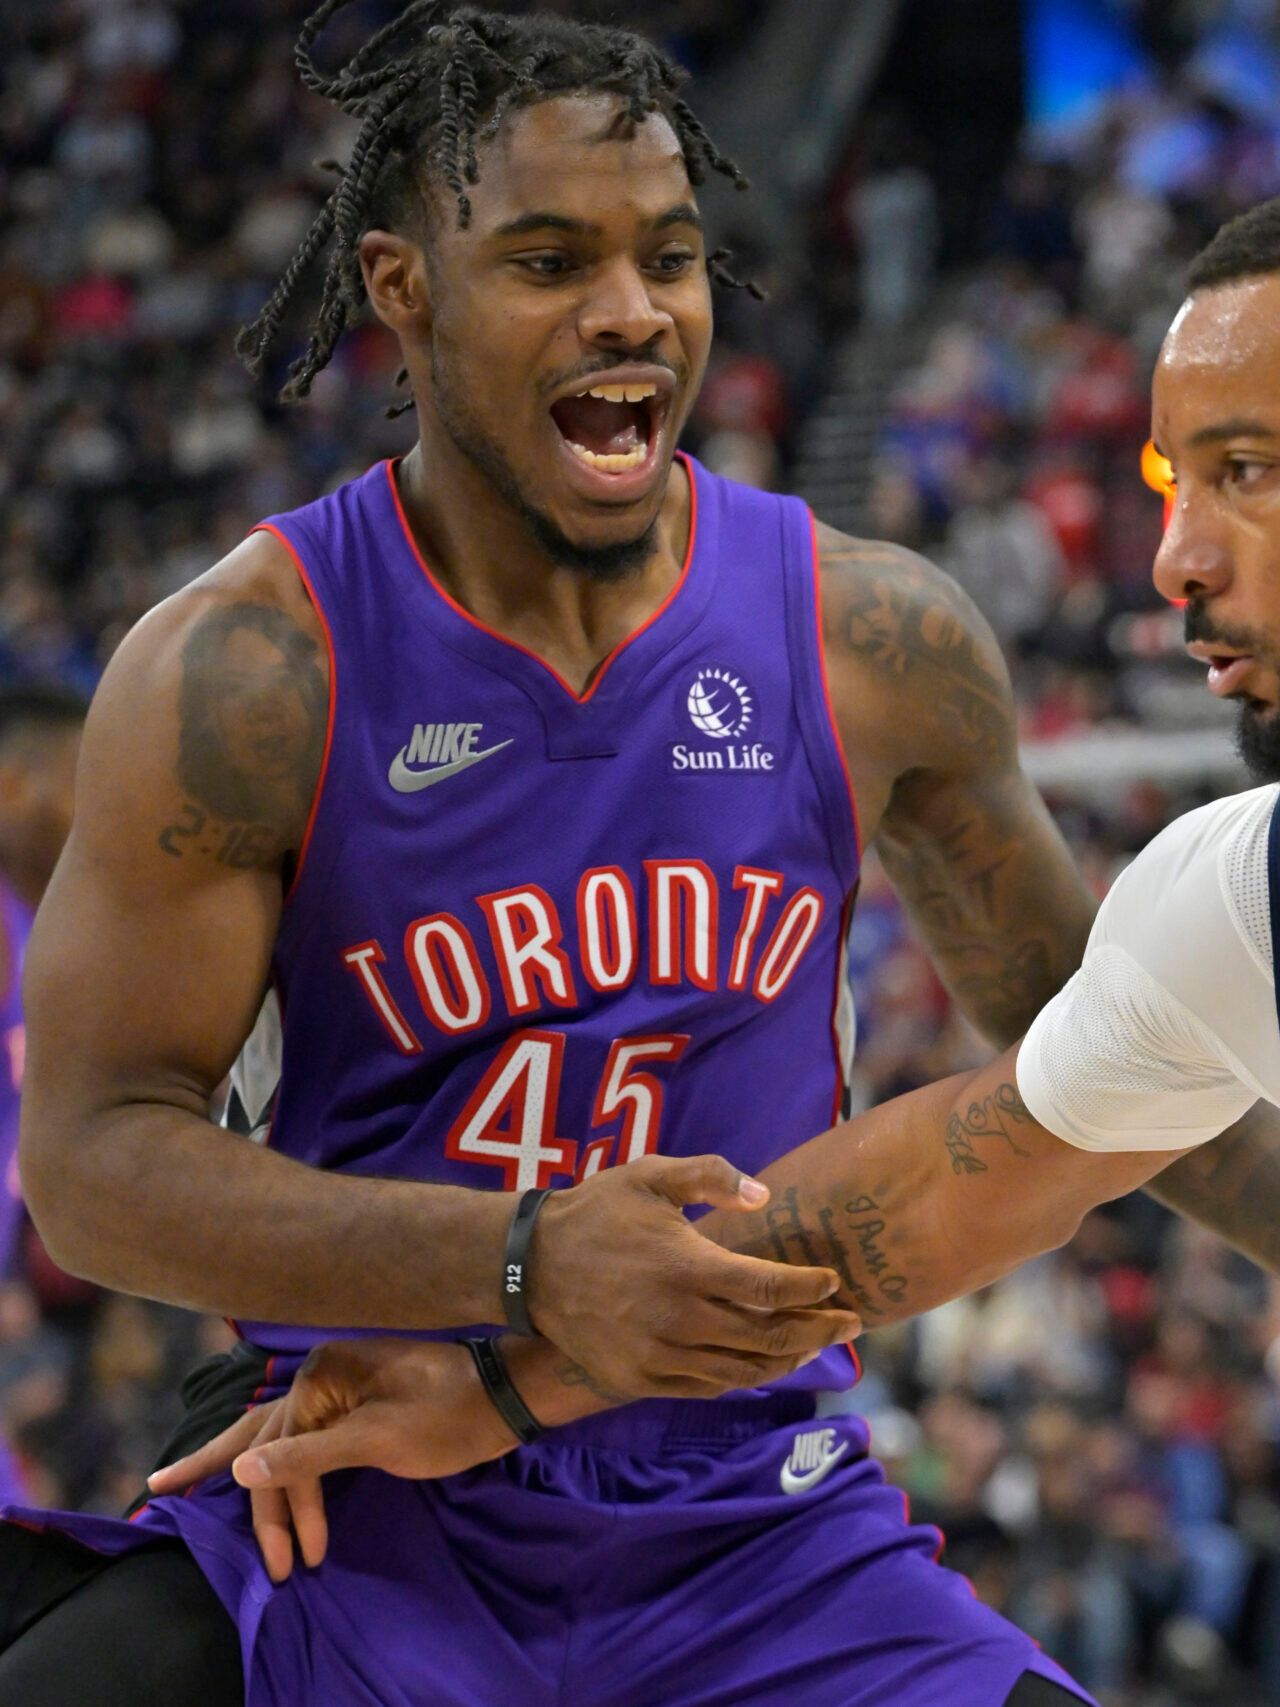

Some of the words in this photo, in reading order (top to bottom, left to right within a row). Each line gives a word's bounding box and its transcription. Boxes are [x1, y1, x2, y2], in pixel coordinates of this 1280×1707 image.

[405, 722, 484, 764] NIKE
[672, 744, 724, 770] Sun
[726, 743, 774, 770] Life
[341, 858, 825, 1056] TORONTO
[444, 1028, 692, 1192] 45
[506, 1263, 523, 1294] 912
[790, 1427, 837, 1472] NIKE
